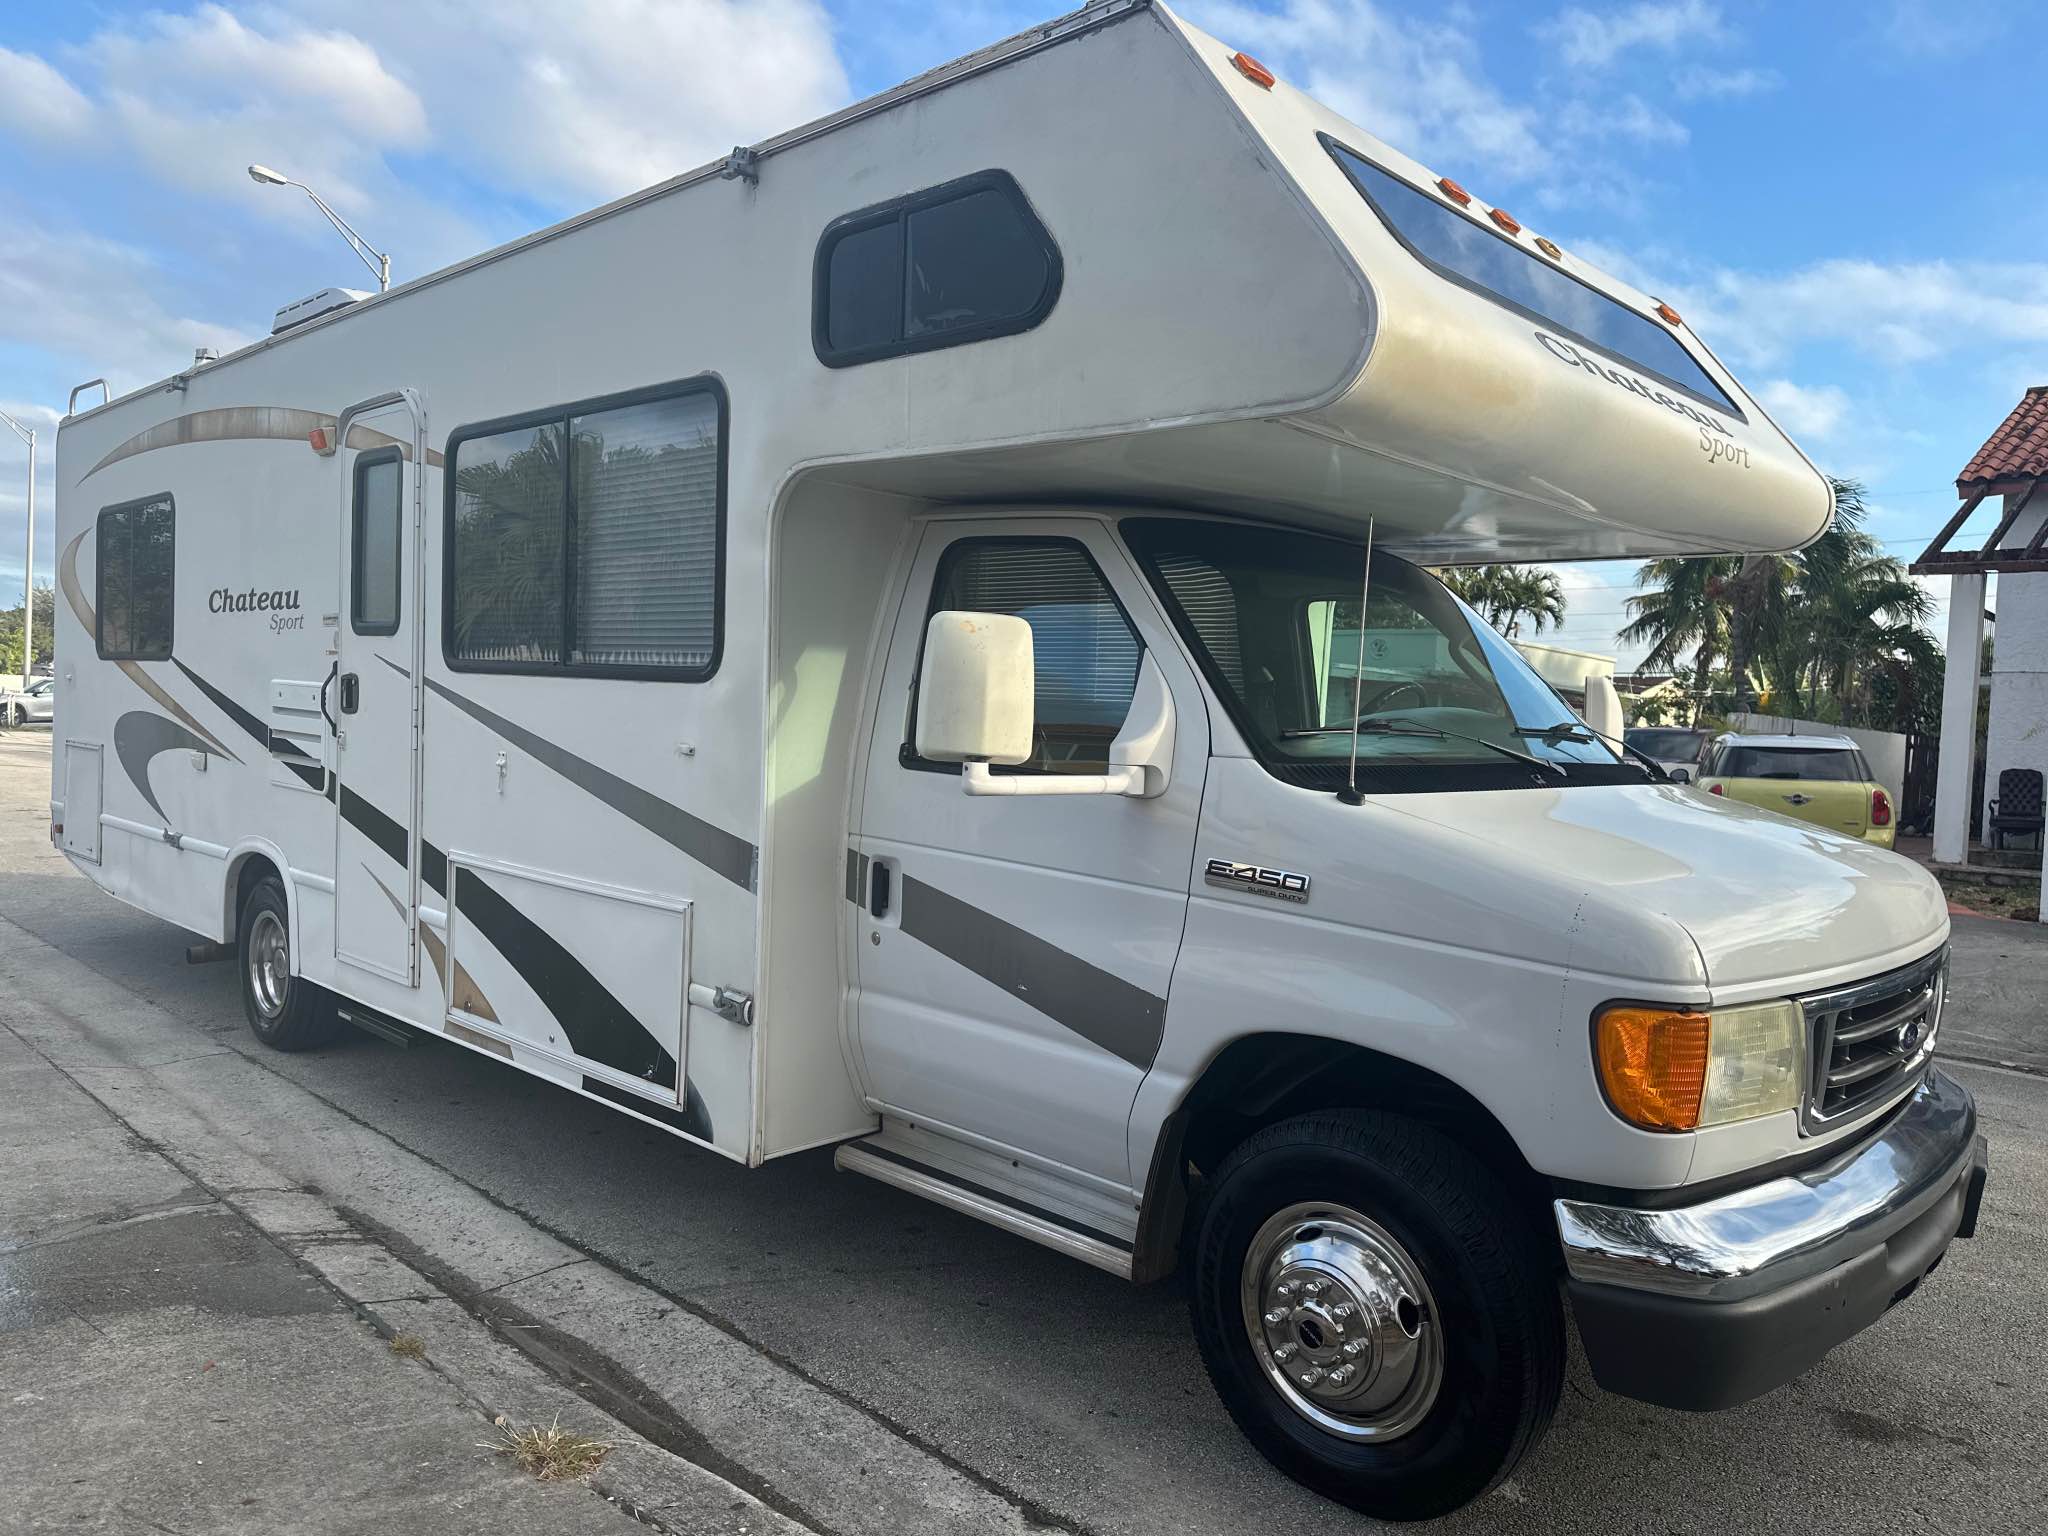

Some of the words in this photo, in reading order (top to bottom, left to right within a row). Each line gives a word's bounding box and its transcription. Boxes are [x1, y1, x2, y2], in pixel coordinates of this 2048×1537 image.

[1534, 331, 1734, 438] Chateau
[1698, 427, 1751, 469] Sport
[208, 587, 300, 613] Chateau
[269, 613, 305, 634] Sport
[1247, 886, 1277, 898] SUPER
[1278, 891, 1304, 903] DUTY
